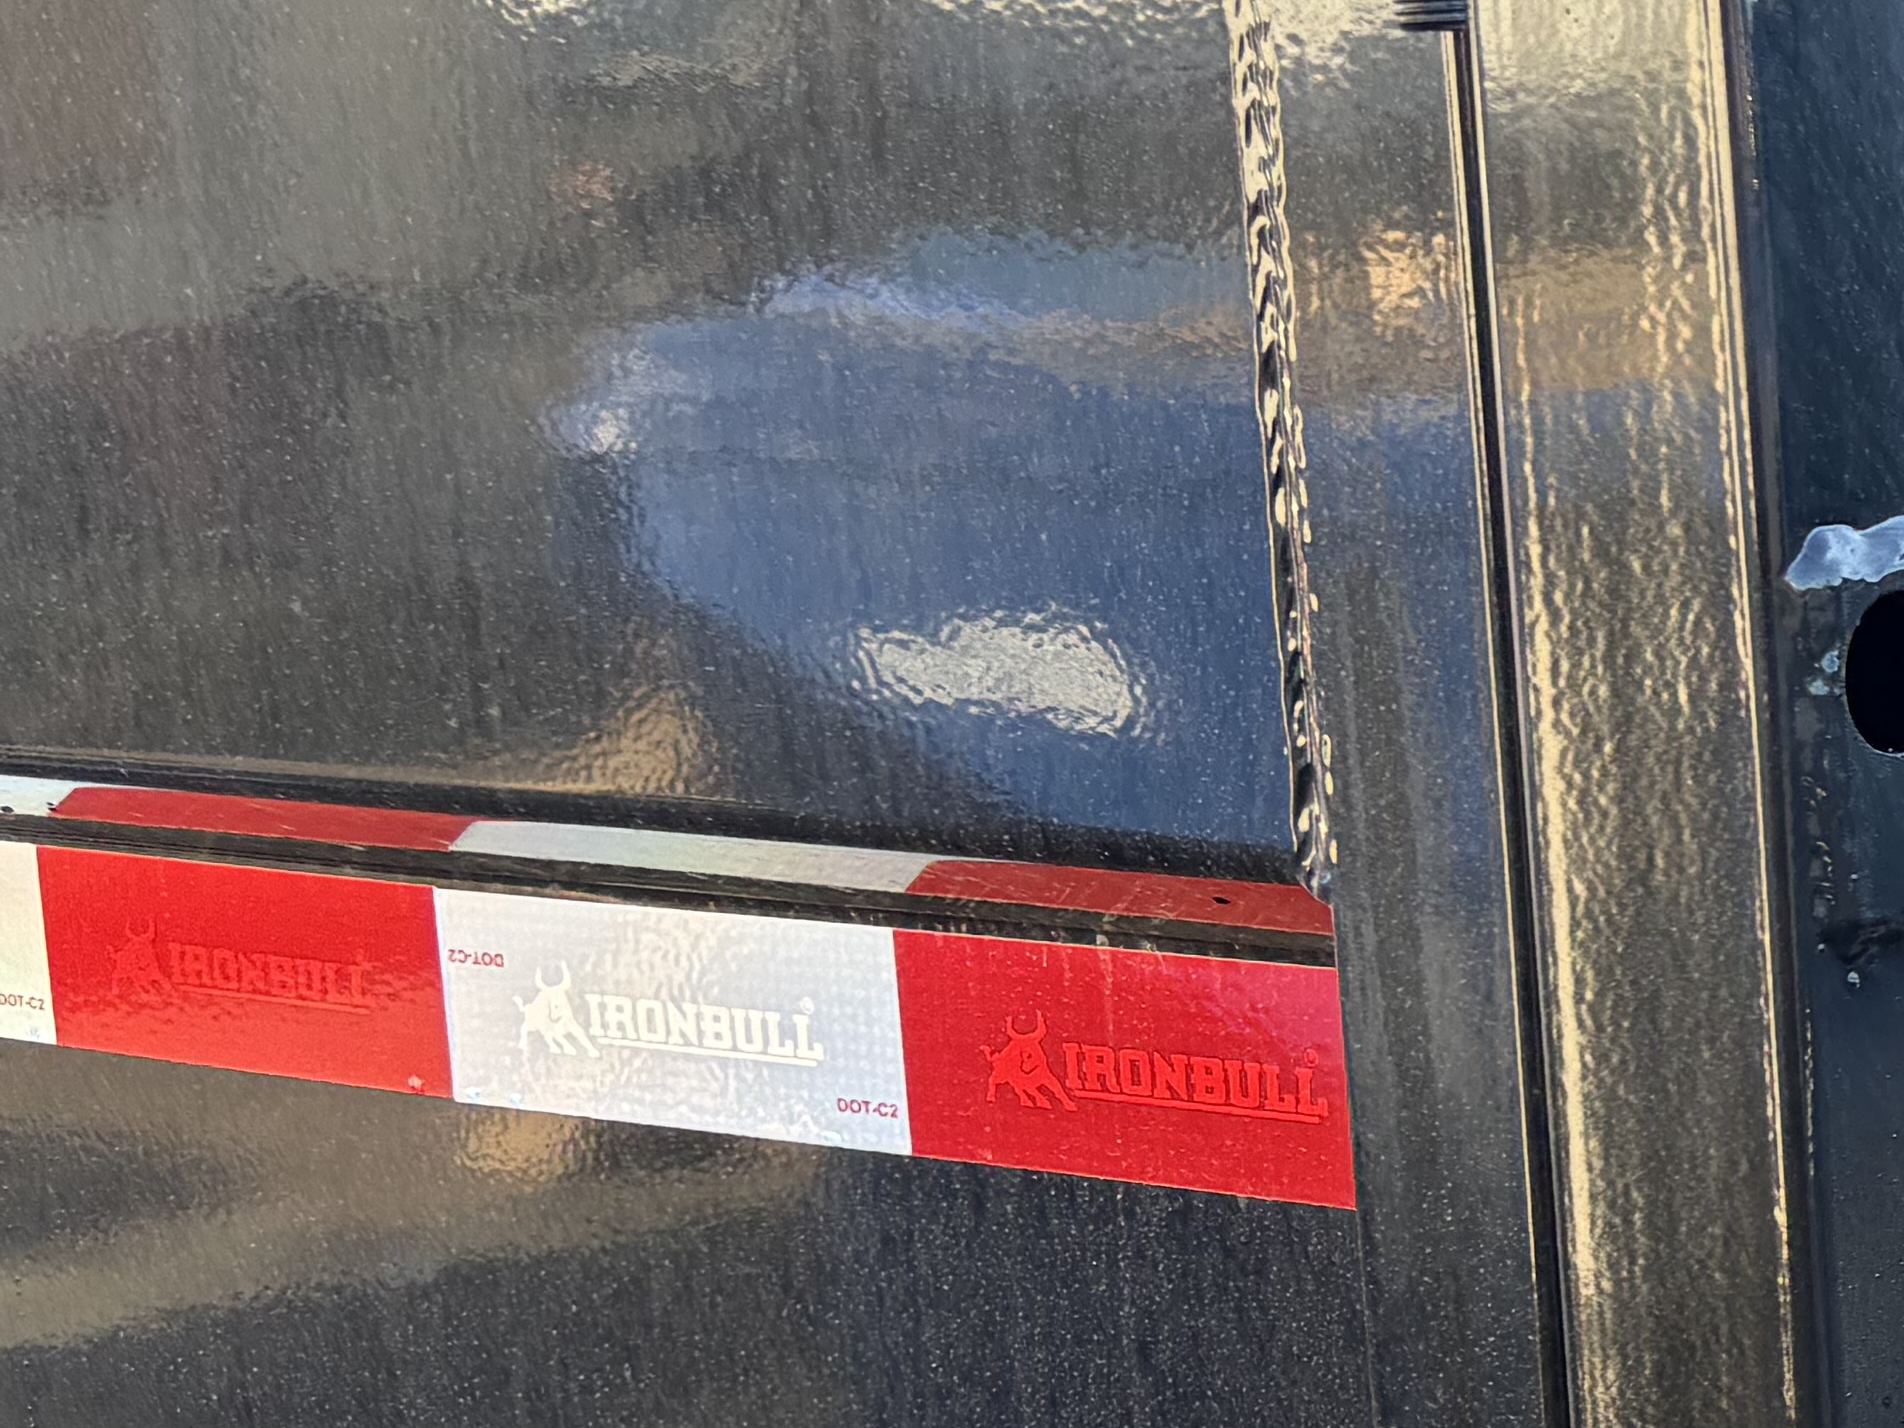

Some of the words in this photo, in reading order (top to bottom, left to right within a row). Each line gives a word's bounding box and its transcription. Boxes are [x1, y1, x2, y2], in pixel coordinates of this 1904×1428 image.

[168, 941, 374, 1007] IRONBULL
[447, 948, 505, 968] DOT-C2
[584, 993, 824, 1061] IRONBULL
[836, 1097, 899, 1119] DOT-C2
[1062, 1042, 1329, 1117] IRONBULL
